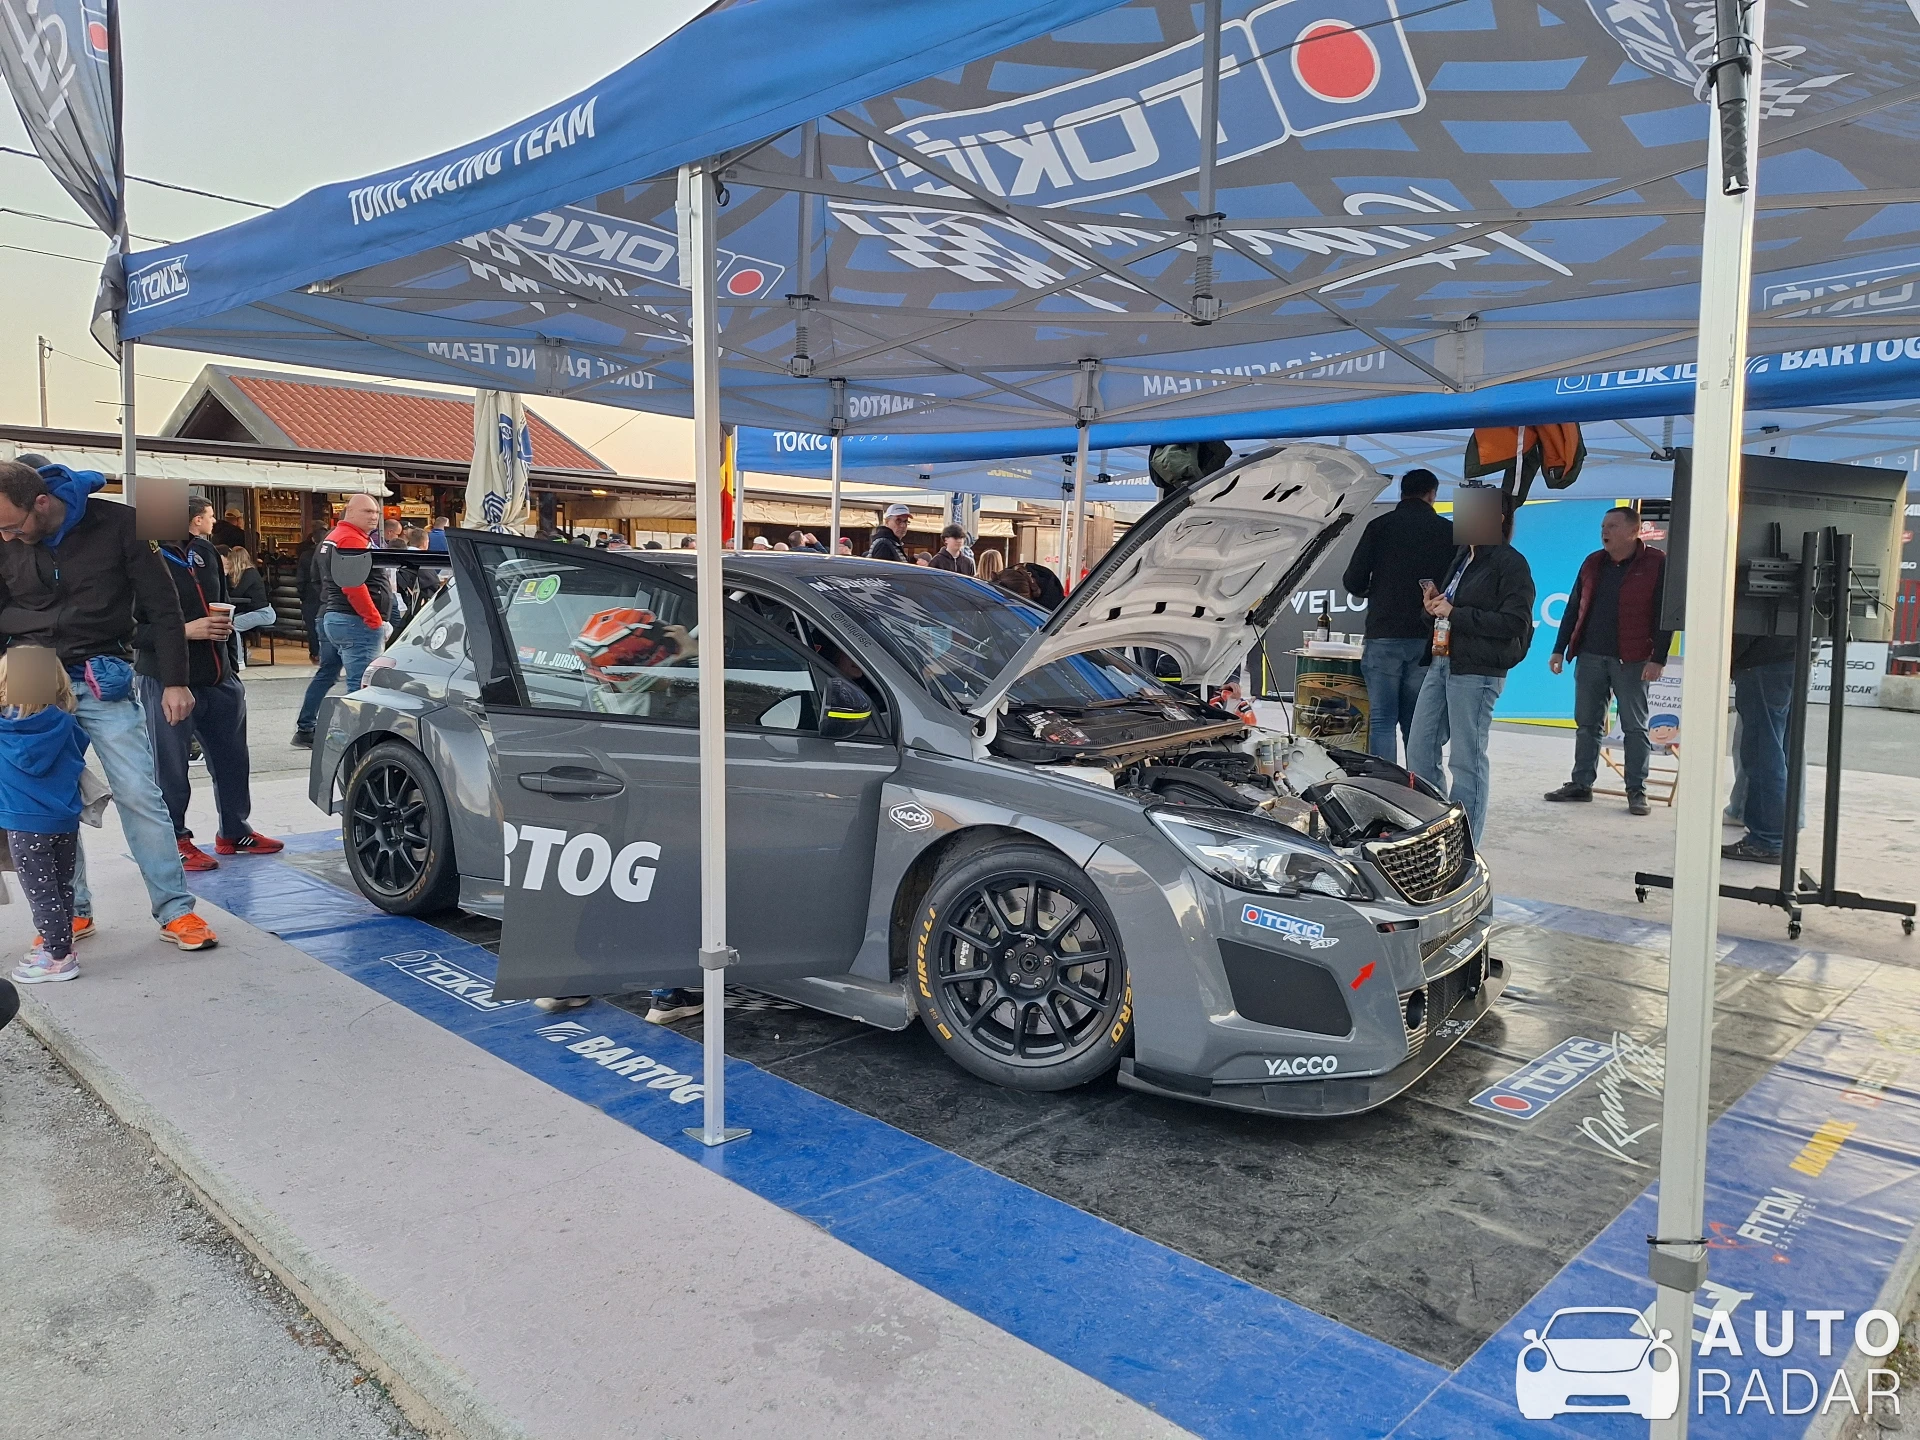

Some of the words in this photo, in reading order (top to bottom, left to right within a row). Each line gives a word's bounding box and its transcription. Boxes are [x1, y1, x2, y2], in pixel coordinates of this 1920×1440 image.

[348, 173, 414, 226] TOKIĆ
[409, 143, 511, 204] RACING
[510, 95, 598, 166] TEAM
[141, 260, 188, 304] TOKIĆ
[1290, 589, 1369, 615] VELO
[534, 650, 547, 665] M.
[896, 809, 928, 824] YACCO
[1262, 911, 1322, 939] TOKIĆ
[917, 907, 936, 998] PIRELLI
[566, 1036, 705, 1105] BARTOG
[1264, 1055, 1338, 1076] YACCO
[1512, 1037, 1612, 1096] TOKIĆ
[1736, 1186, 1806, 1246] ATOM
